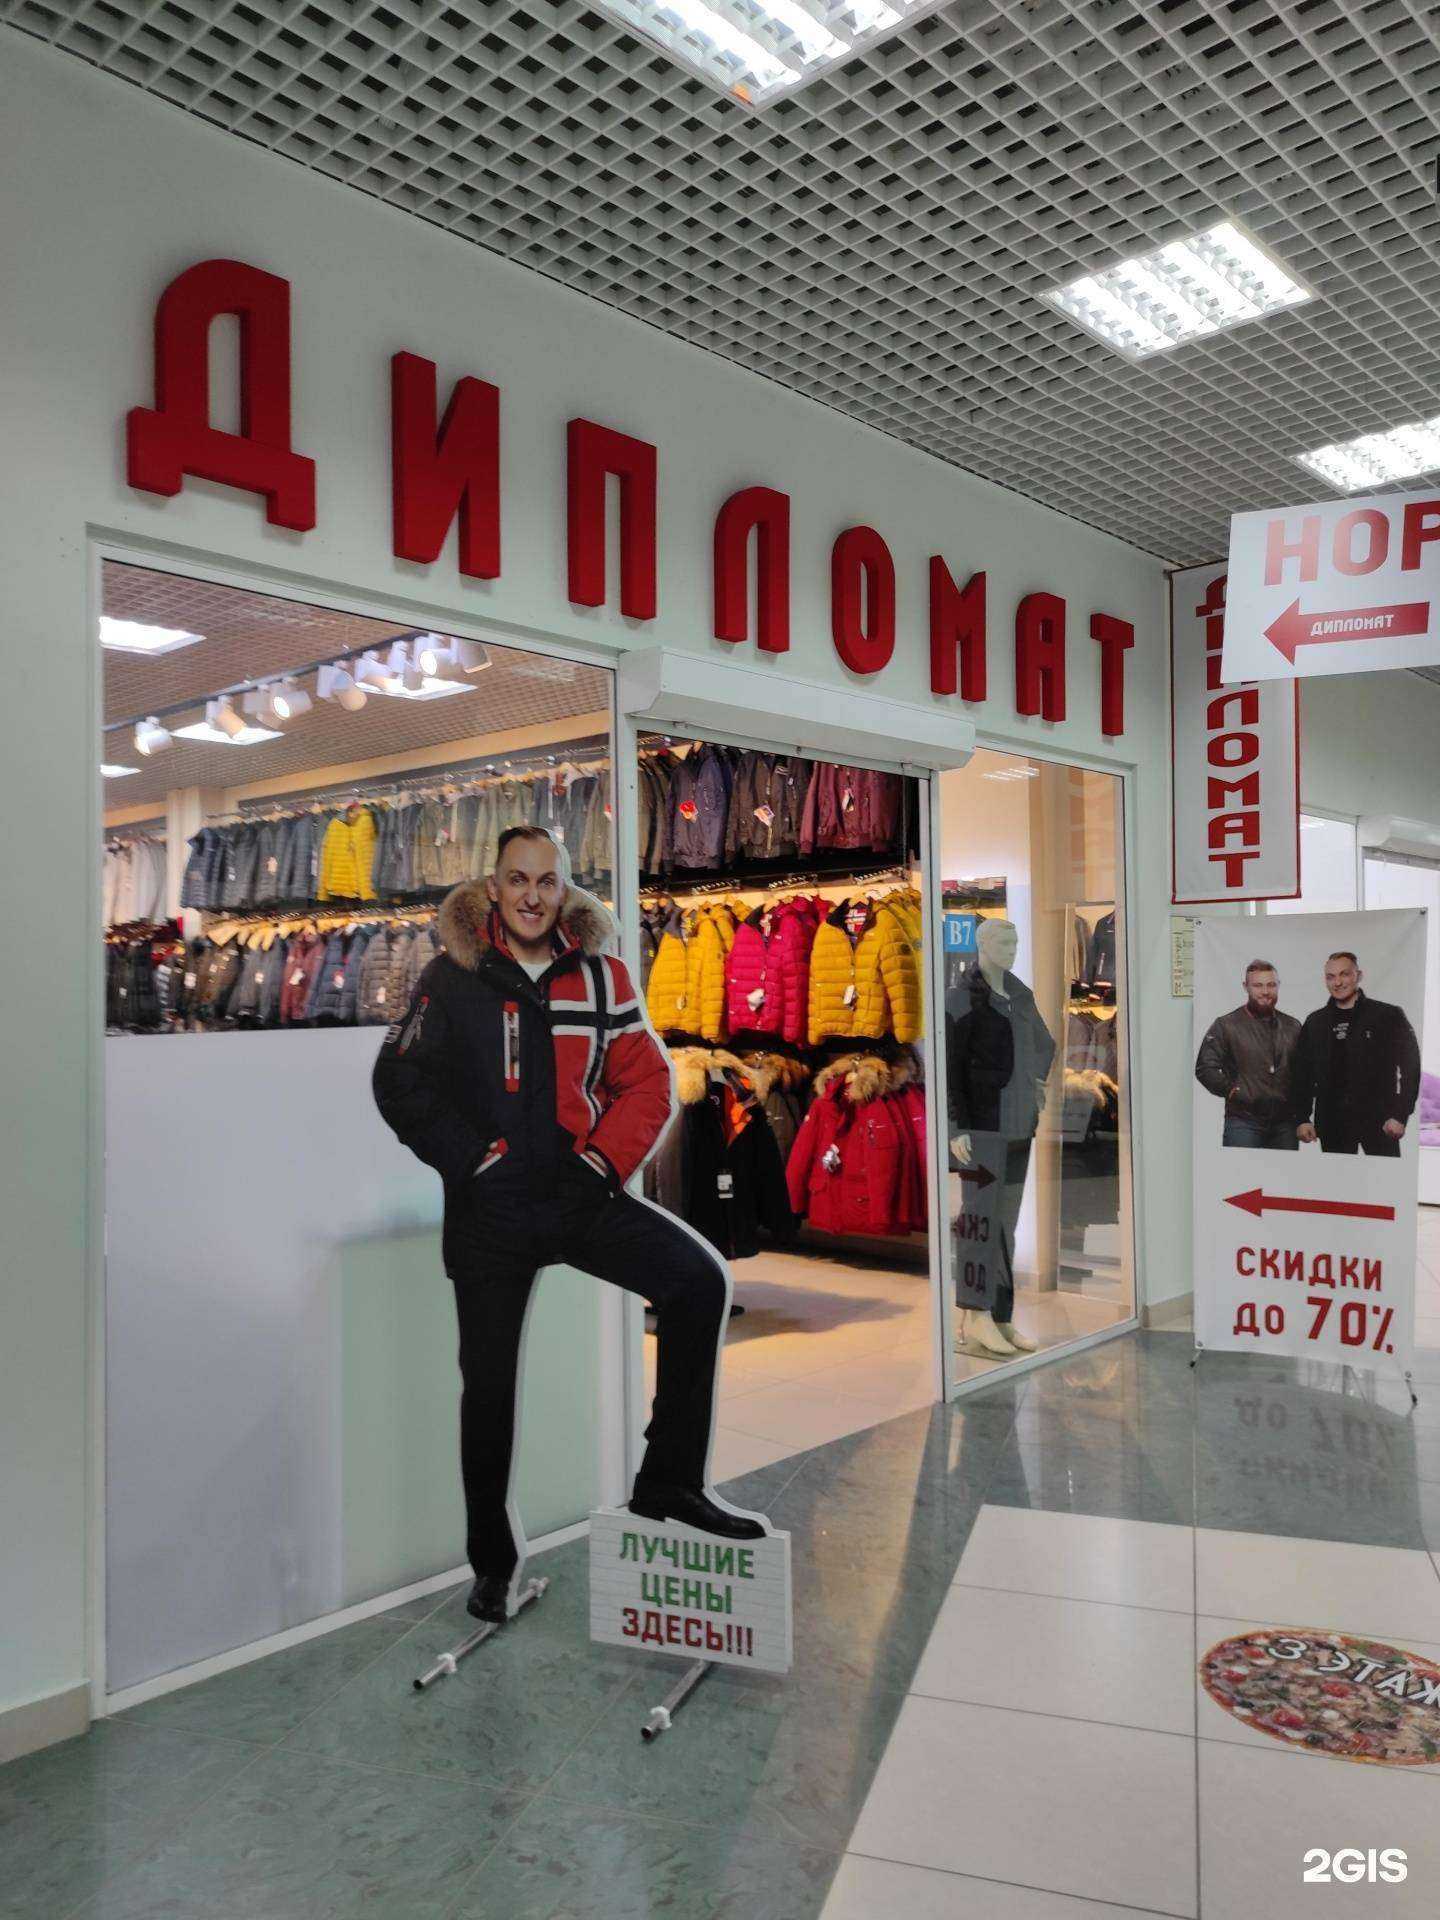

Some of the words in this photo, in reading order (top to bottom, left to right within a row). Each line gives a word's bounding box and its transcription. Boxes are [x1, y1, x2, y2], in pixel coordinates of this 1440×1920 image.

[127, 258, 1134, 736] ДИПЛОМАТ
[1310, 614, 1395, 637] ДИПЛОМАТ
[1236, 1246, 1382, 1292] СКИДКИ
[1233, 1302, 1285, 1337] ДО
[1306, 1296, 1394, 1354] 70%
[620, 1532, 755, 1579] ЛУЧШИЕ
[641, 1572, 733, 1614] ЦЕНЫ
[621, 1607, 753, 1656] ЗДЕСЬ!!!
